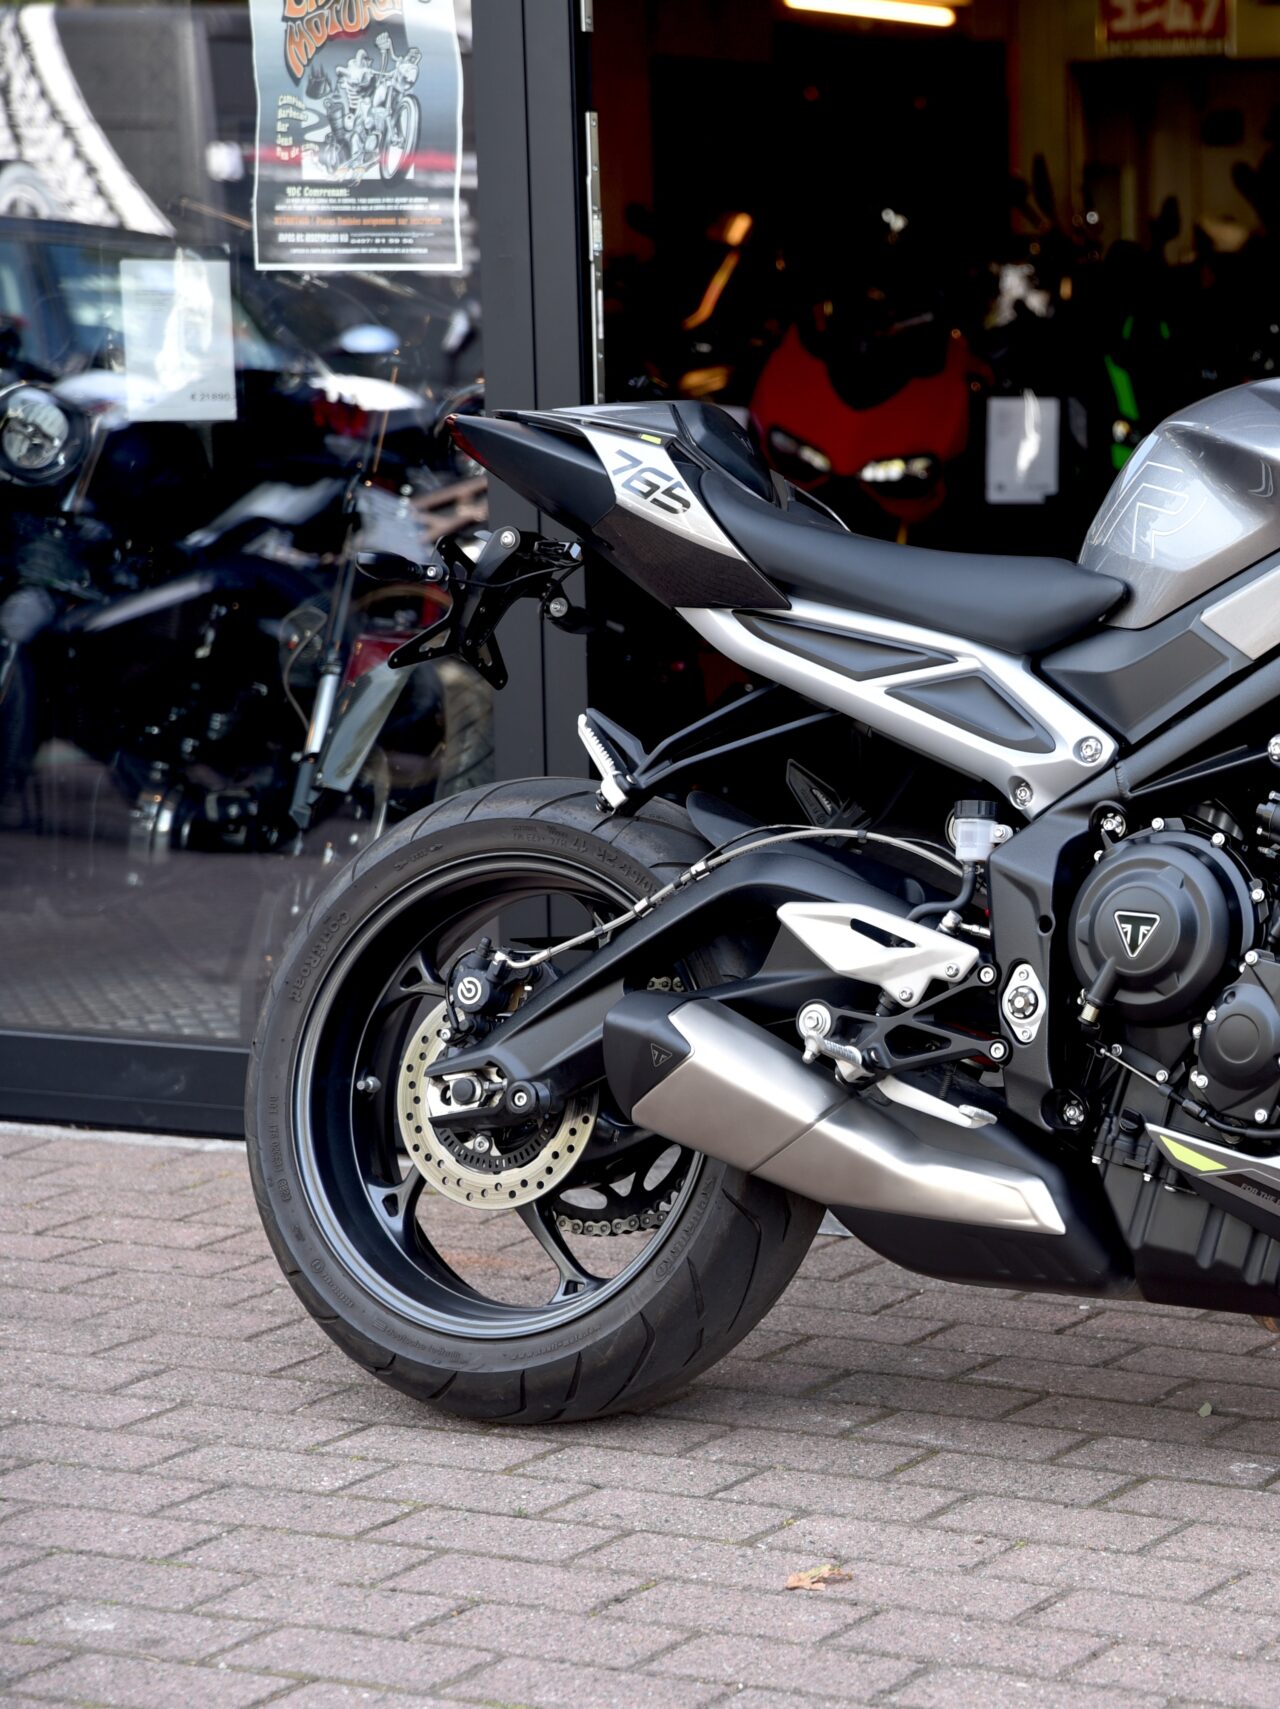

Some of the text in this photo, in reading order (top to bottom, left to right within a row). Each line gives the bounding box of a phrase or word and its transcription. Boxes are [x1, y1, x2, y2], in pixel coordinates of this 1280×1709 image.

[612, 449, 691, 515] 765
[1240, 1183, 1259, 1195] FOR
[1260, 1191, 1277, 1202] THE
